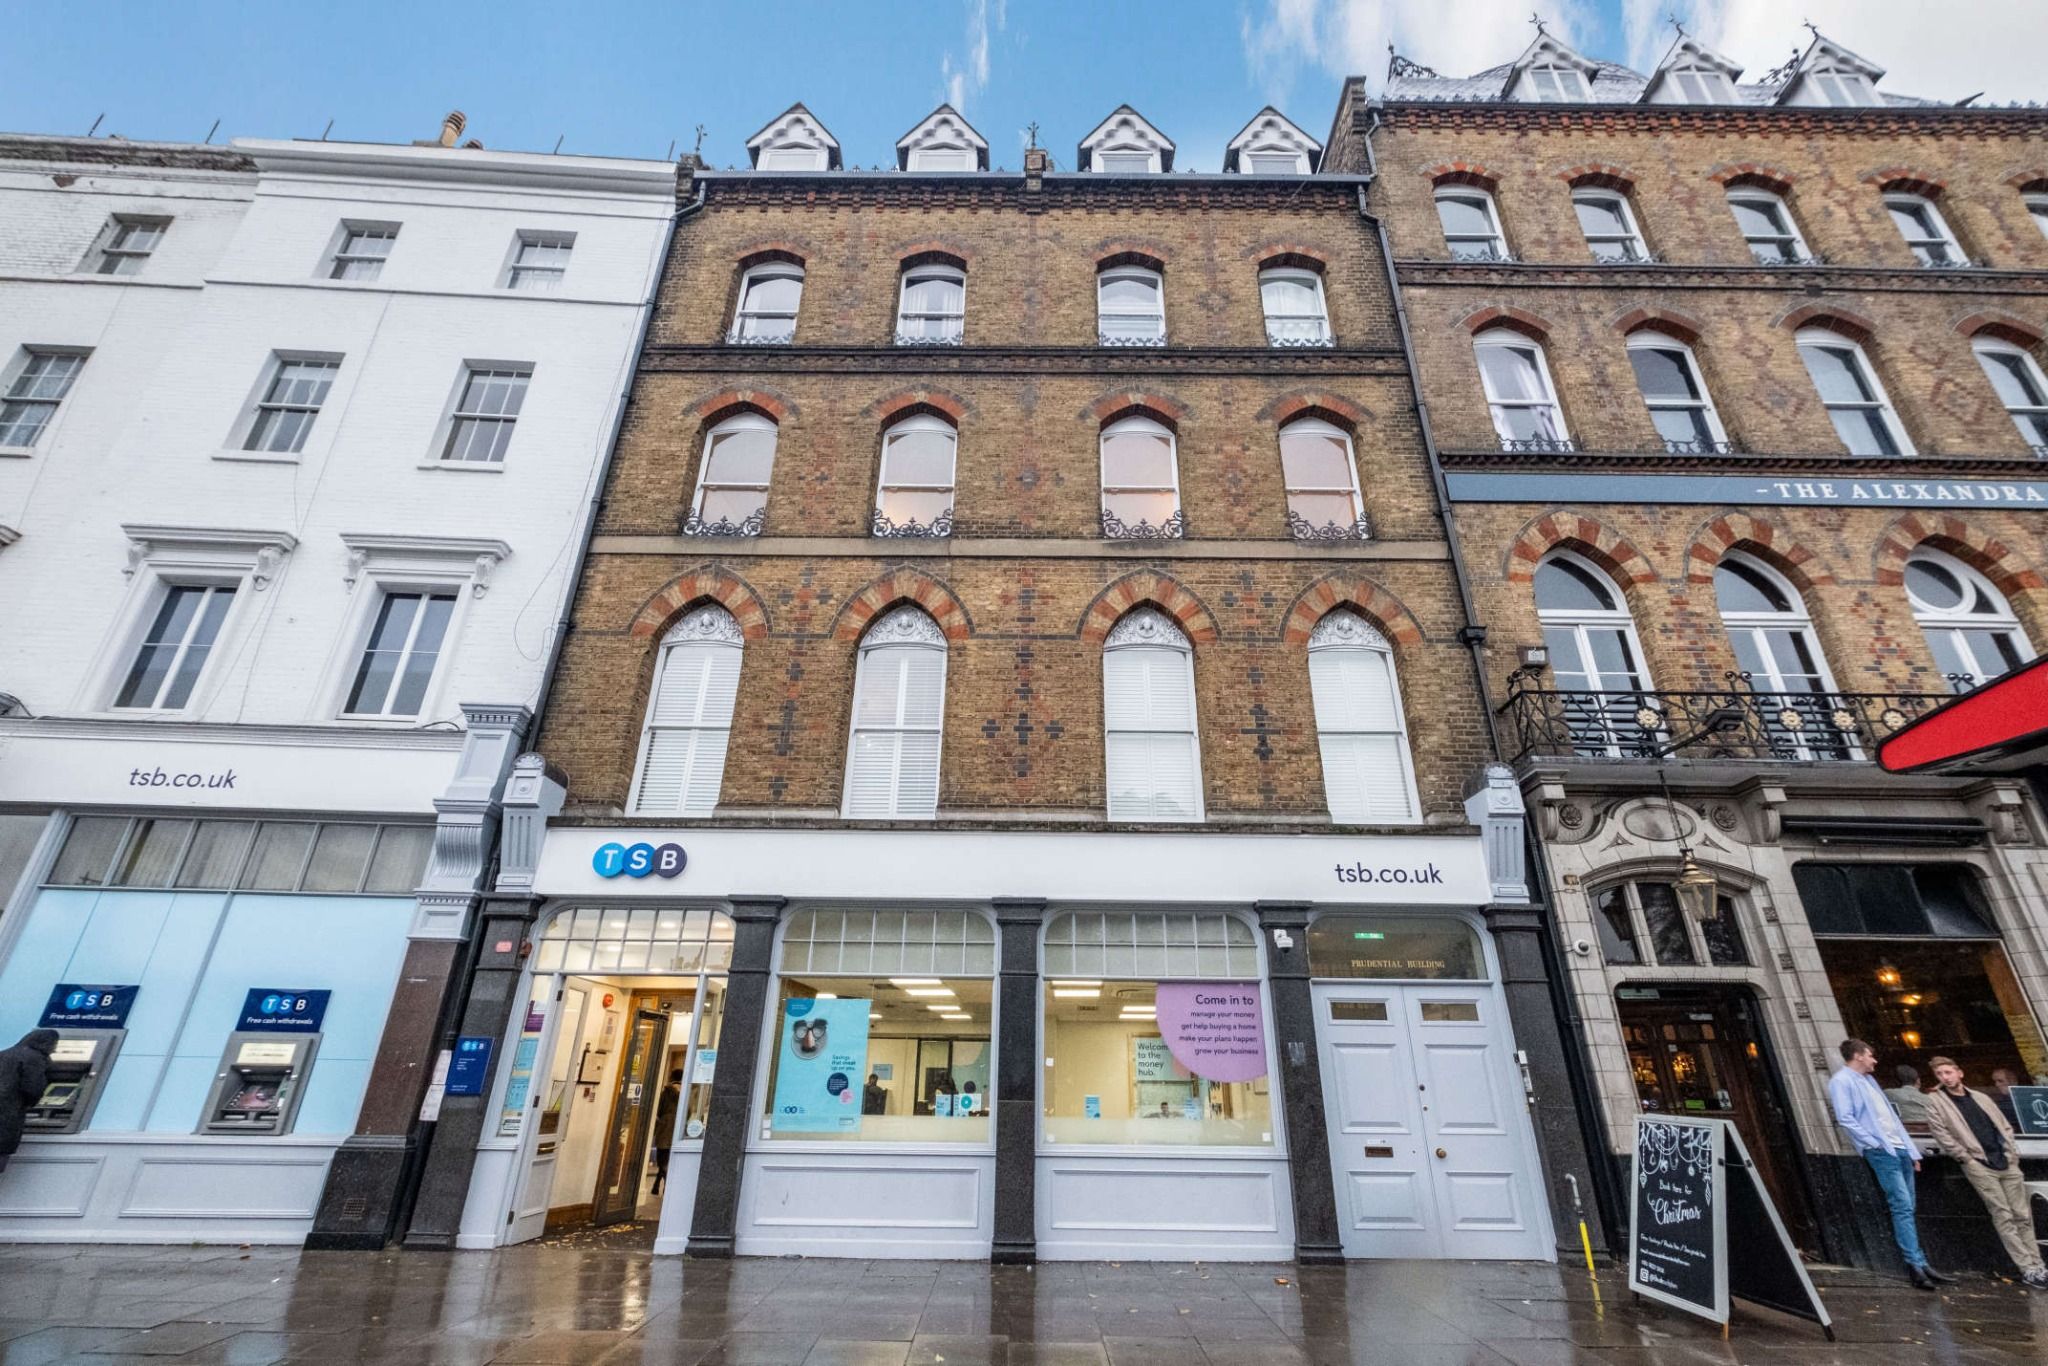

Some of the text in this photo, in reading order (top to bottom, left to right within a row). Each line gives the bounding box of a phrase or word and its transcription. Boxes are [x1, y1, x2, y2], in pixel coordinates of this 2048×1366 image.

[1851, 483, 2046, 502] ALEXANDRA
[129, 766, 238, 789] tsb.co.uk
[601, 847, 680, 872] TSB
[1334, 861, 1444, 884] tsb.co.uk
[1351, 959, 1445, 969] PRUDENTIAL BUILDING
[70, 993, 115, 1008] TSB
[265, 997, 308, 1012] TSB
[1195, 994, 1254, 1006] Come in to
[1190, 1011, 1255, 1019] manage your money
[1209, 1023, 1232, 1031] buying
[1214, 1035, 1232, 1043] plans
[1232, 1035, 1258, 1043] happen
[1137, 1042, 1169, 1050] Welcom
[1138, 1051, 1161, 1059] to the
[1138, 1060, 1164, 1068] money
[1138, 1068, 1154, 1076] hub.
[1647, 1193, 1702, 1225] Christmas
